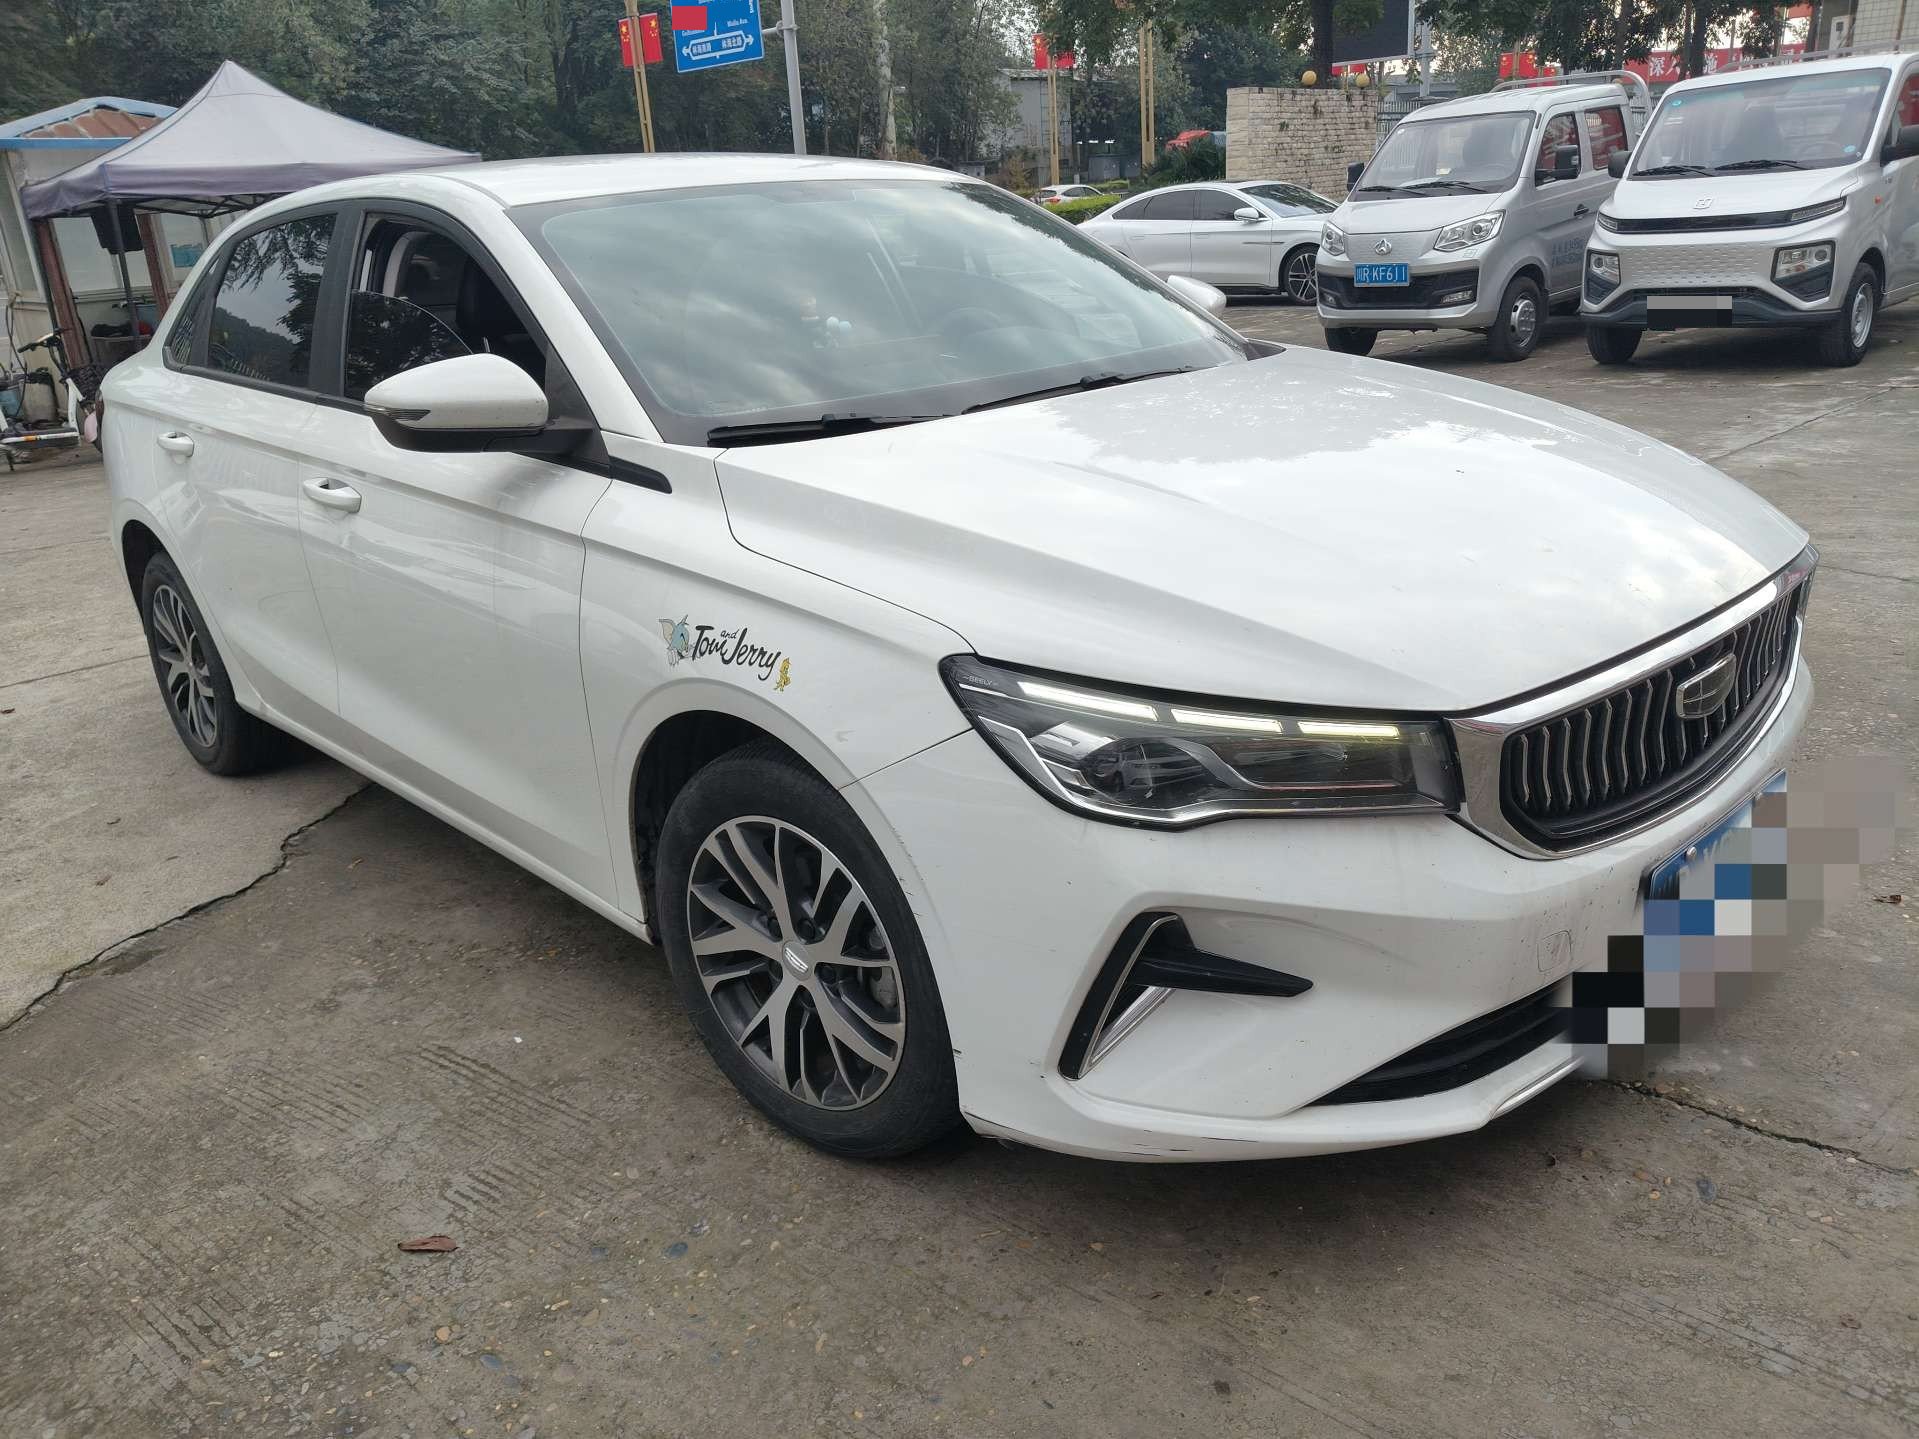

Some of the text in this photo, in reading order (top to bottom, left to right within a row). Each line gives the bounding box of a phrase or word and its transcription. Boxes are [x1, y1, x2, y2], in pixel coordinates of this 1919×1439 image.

[692, 625, 781, 681] Tom and Jerry
